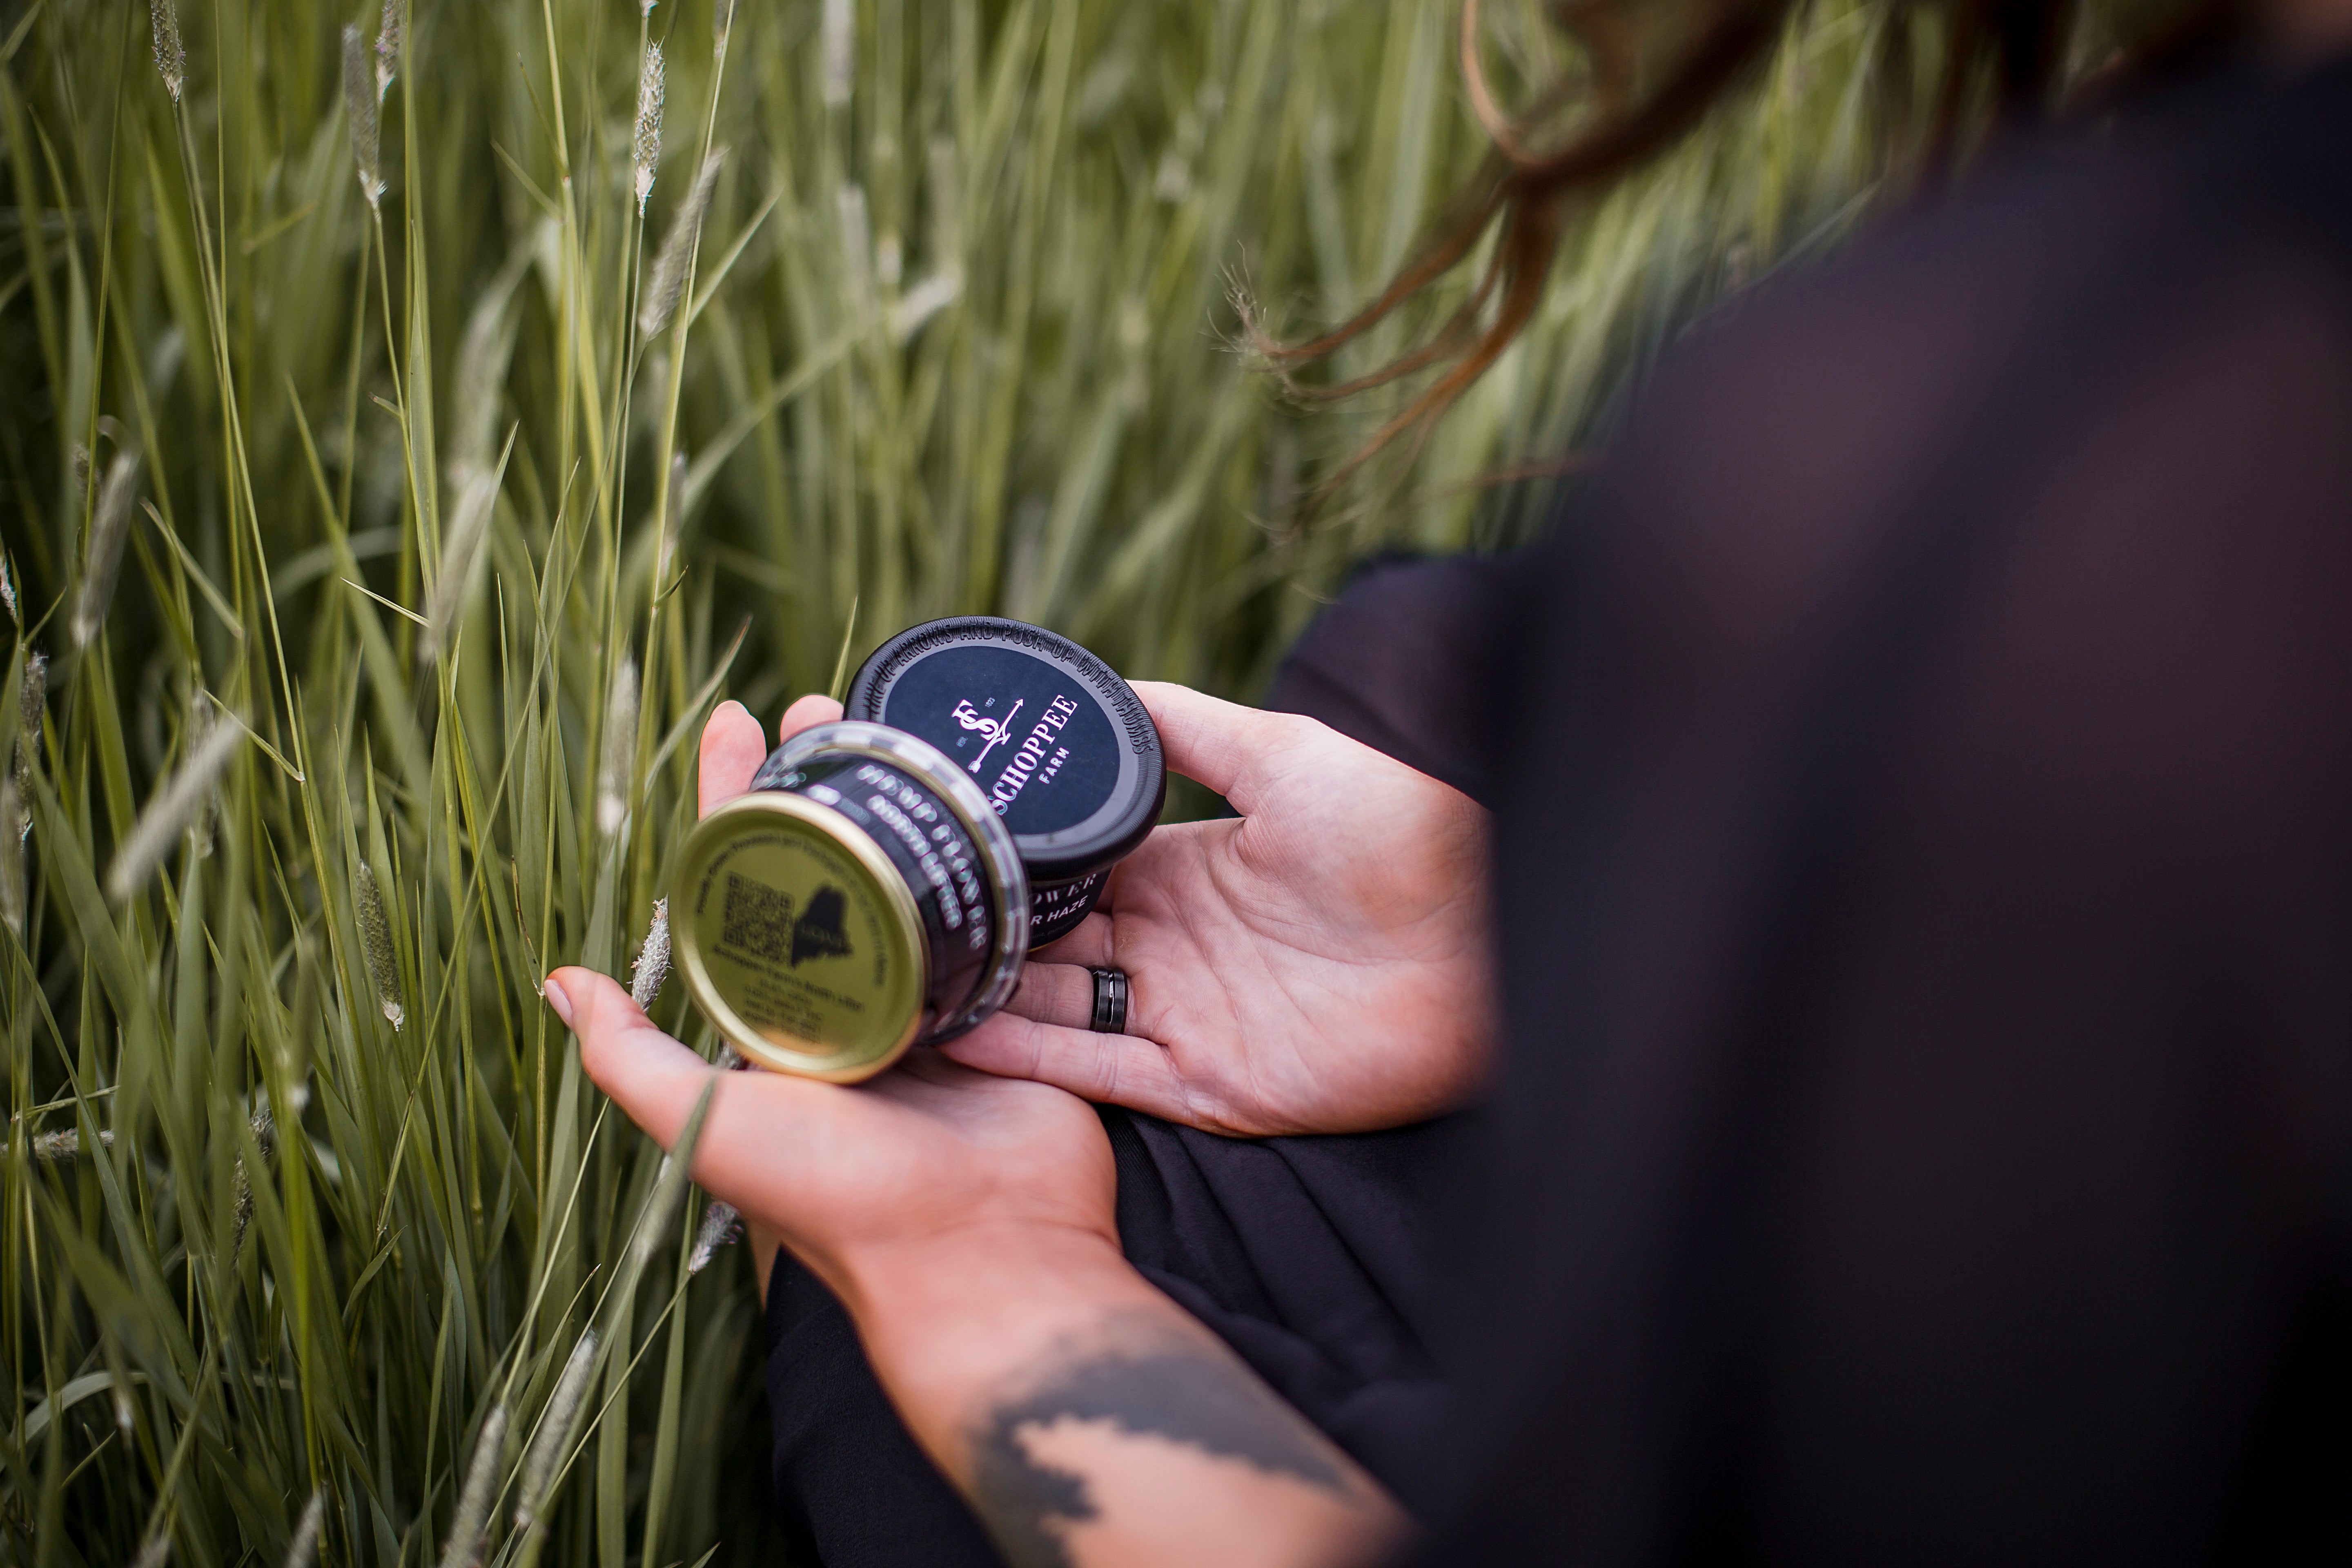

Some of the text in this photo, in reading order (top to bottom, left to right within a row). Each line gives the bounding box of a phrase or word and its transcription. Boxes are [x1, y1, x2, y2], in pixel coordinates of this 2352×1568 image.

[893, 623, 955, 666] ARROWS
[960, 620, 994, 640] AND
[1001, 623, 1048, 653] PUSH
[1051, 639, 1078, 662] UP
[1076, 653, 1123, 699] WITH
[1112, 693, 1155, 755] THUMBS
[984, 697, 996, 708] 1823
[987, 694, 1078, 815] SCHOPPEE
[1038, 747, 1070, 784] FARM
[1047, 895, 1088, 922] HAZE
